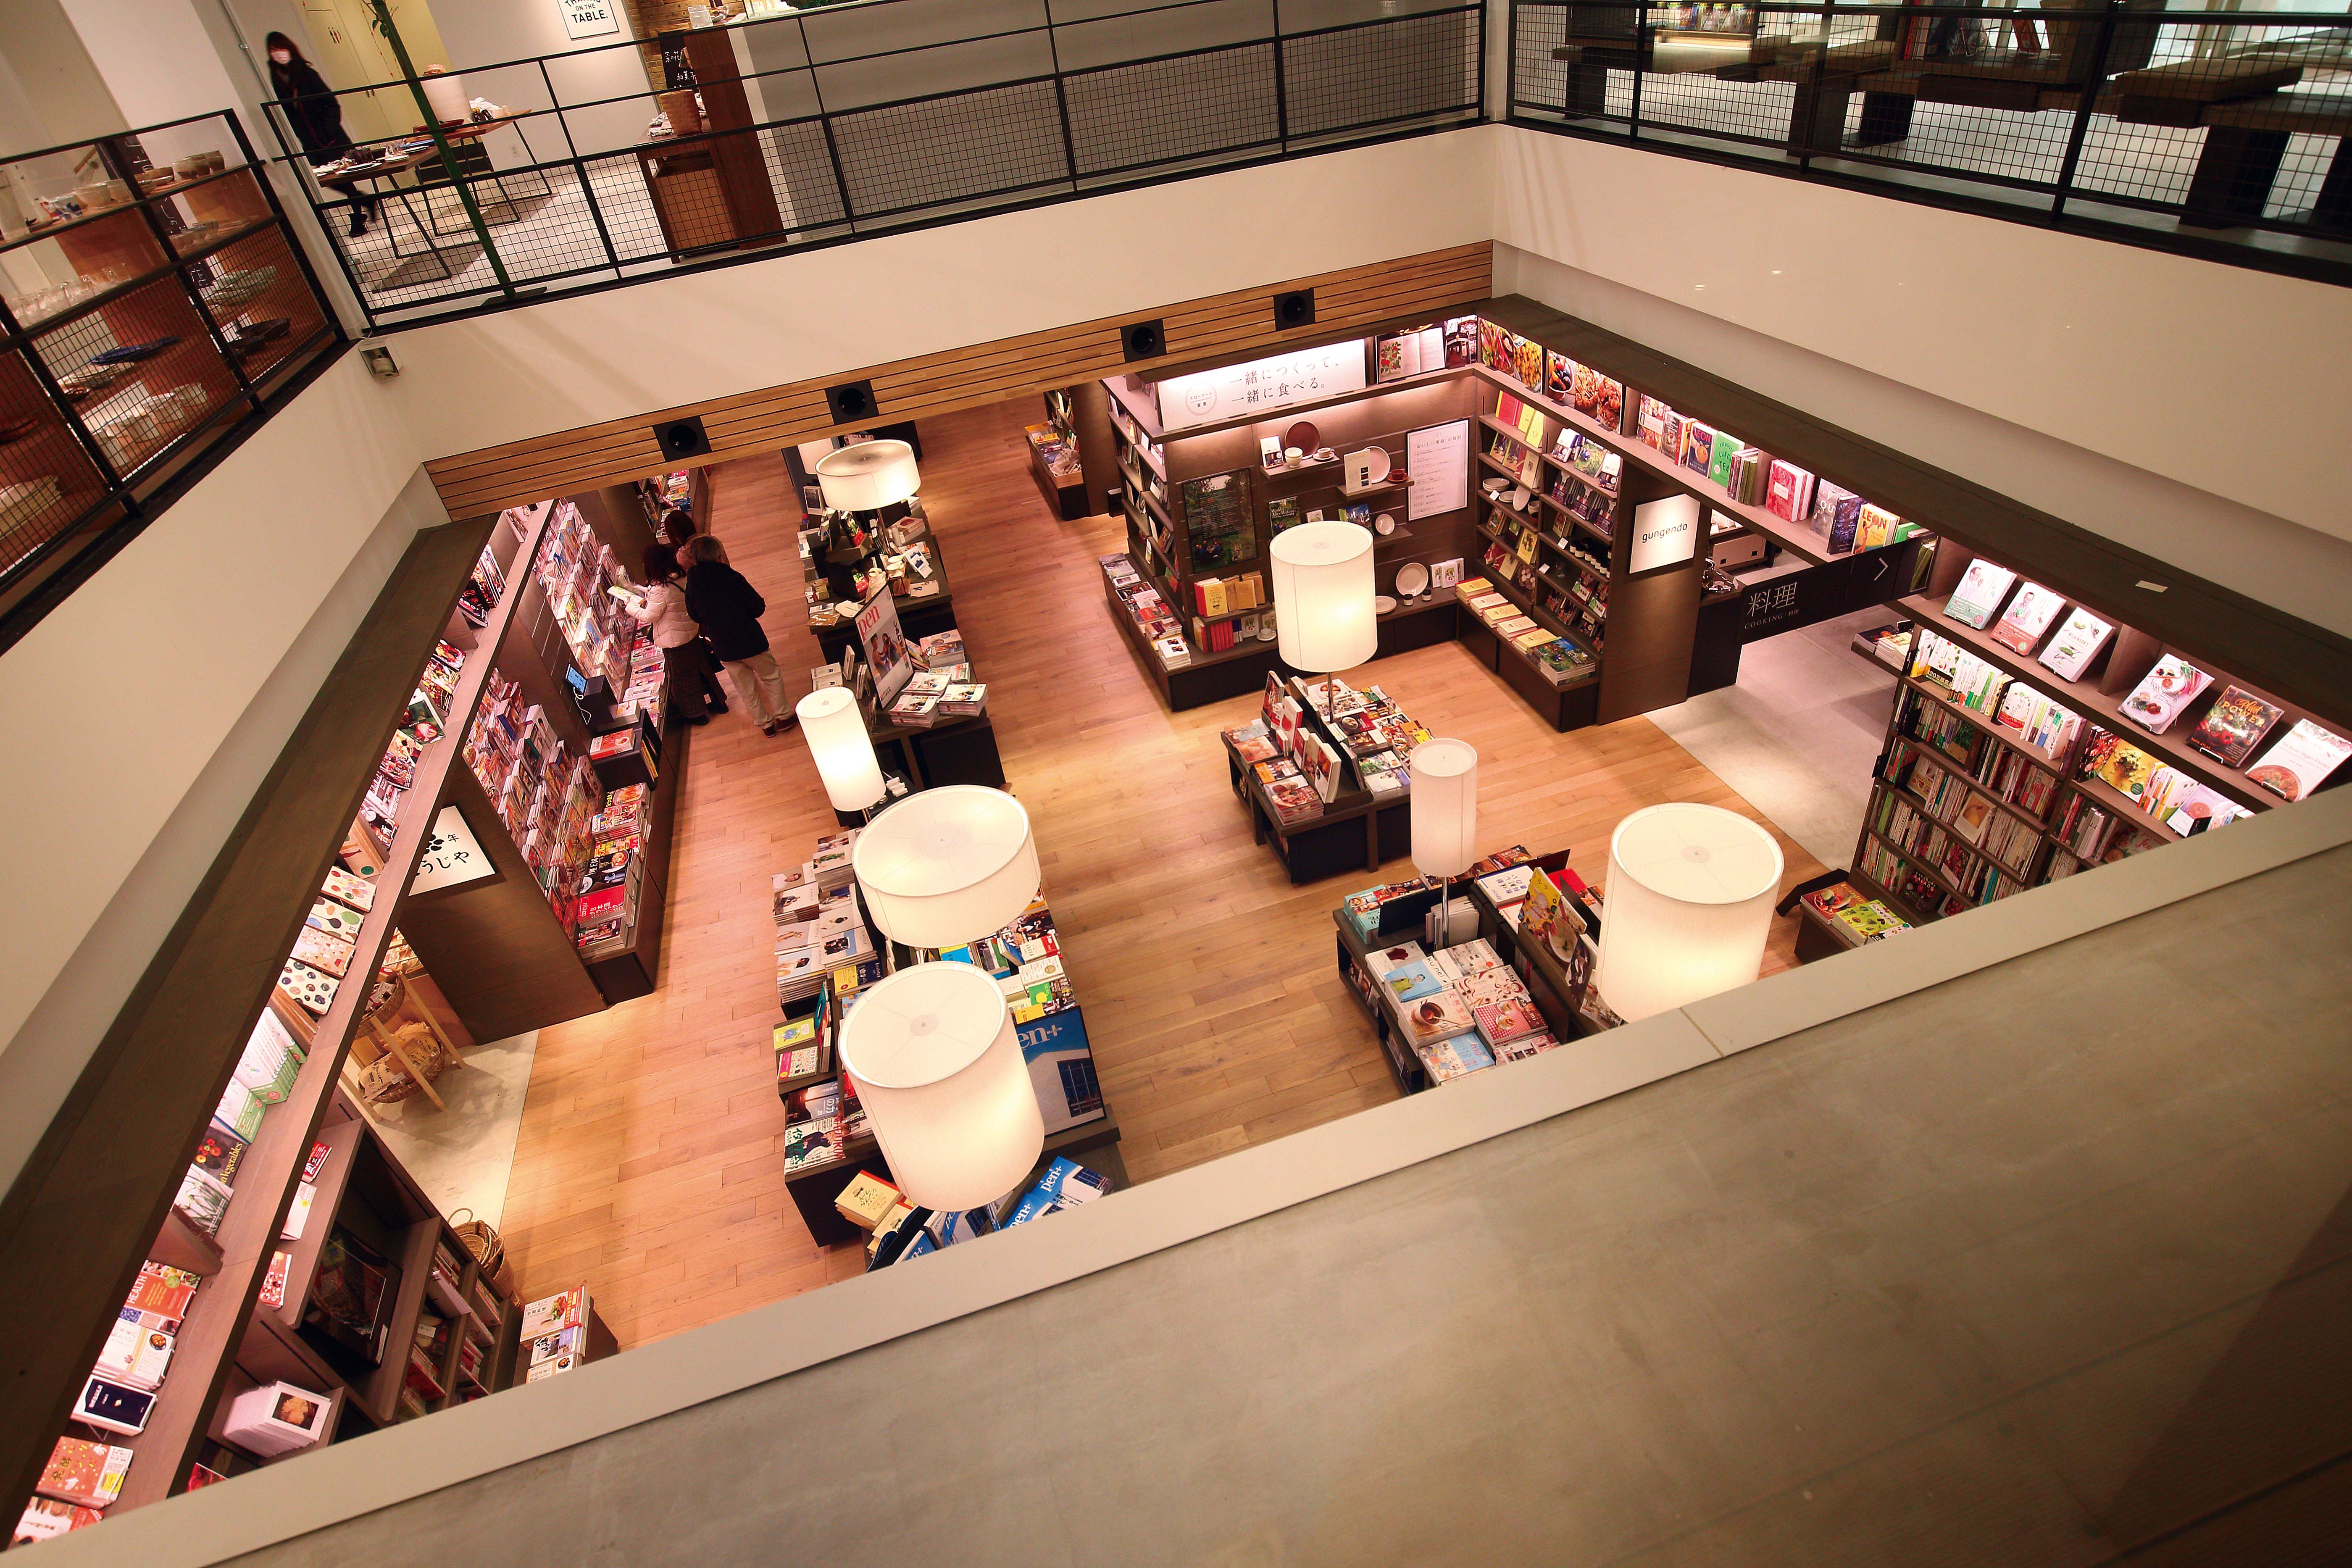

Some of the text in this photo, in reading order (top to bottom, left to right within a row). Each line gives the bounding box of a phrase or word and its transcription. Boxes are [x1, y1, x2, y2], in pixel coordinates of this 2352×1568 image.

[571, 10, 608, 23] TABLE.
[677, 71, 696, 81] 和菓子
[1230, 356, 1339, 386] 一緒につくって、
[1189, 392, 1213, 400] スローフード
[1231, 377, 1325, 404] 一緒に食べる。
[1694, 428, 1711, 444] LEON
[1719, 461, 1729, 473] TEA
[1862, 509, 1887, 530] LEON
[1642, 523, 1688, 543] gungendo
[1747, 581, 1797, 617] 料理
[857, 605, 881, 641] pen
[1744, 613, 1783, 629] COOKING
[2221, 701, 2265, 727] POWER
[416, 852, 469, 876] うじや
[1018, 1025, 1063, 1050] en+
[220, 1142, 242, 1177] Vegetables
[1040, 1165, 1062, 1193] pen+
[126, 1275, 147, 1304] HEALTH
